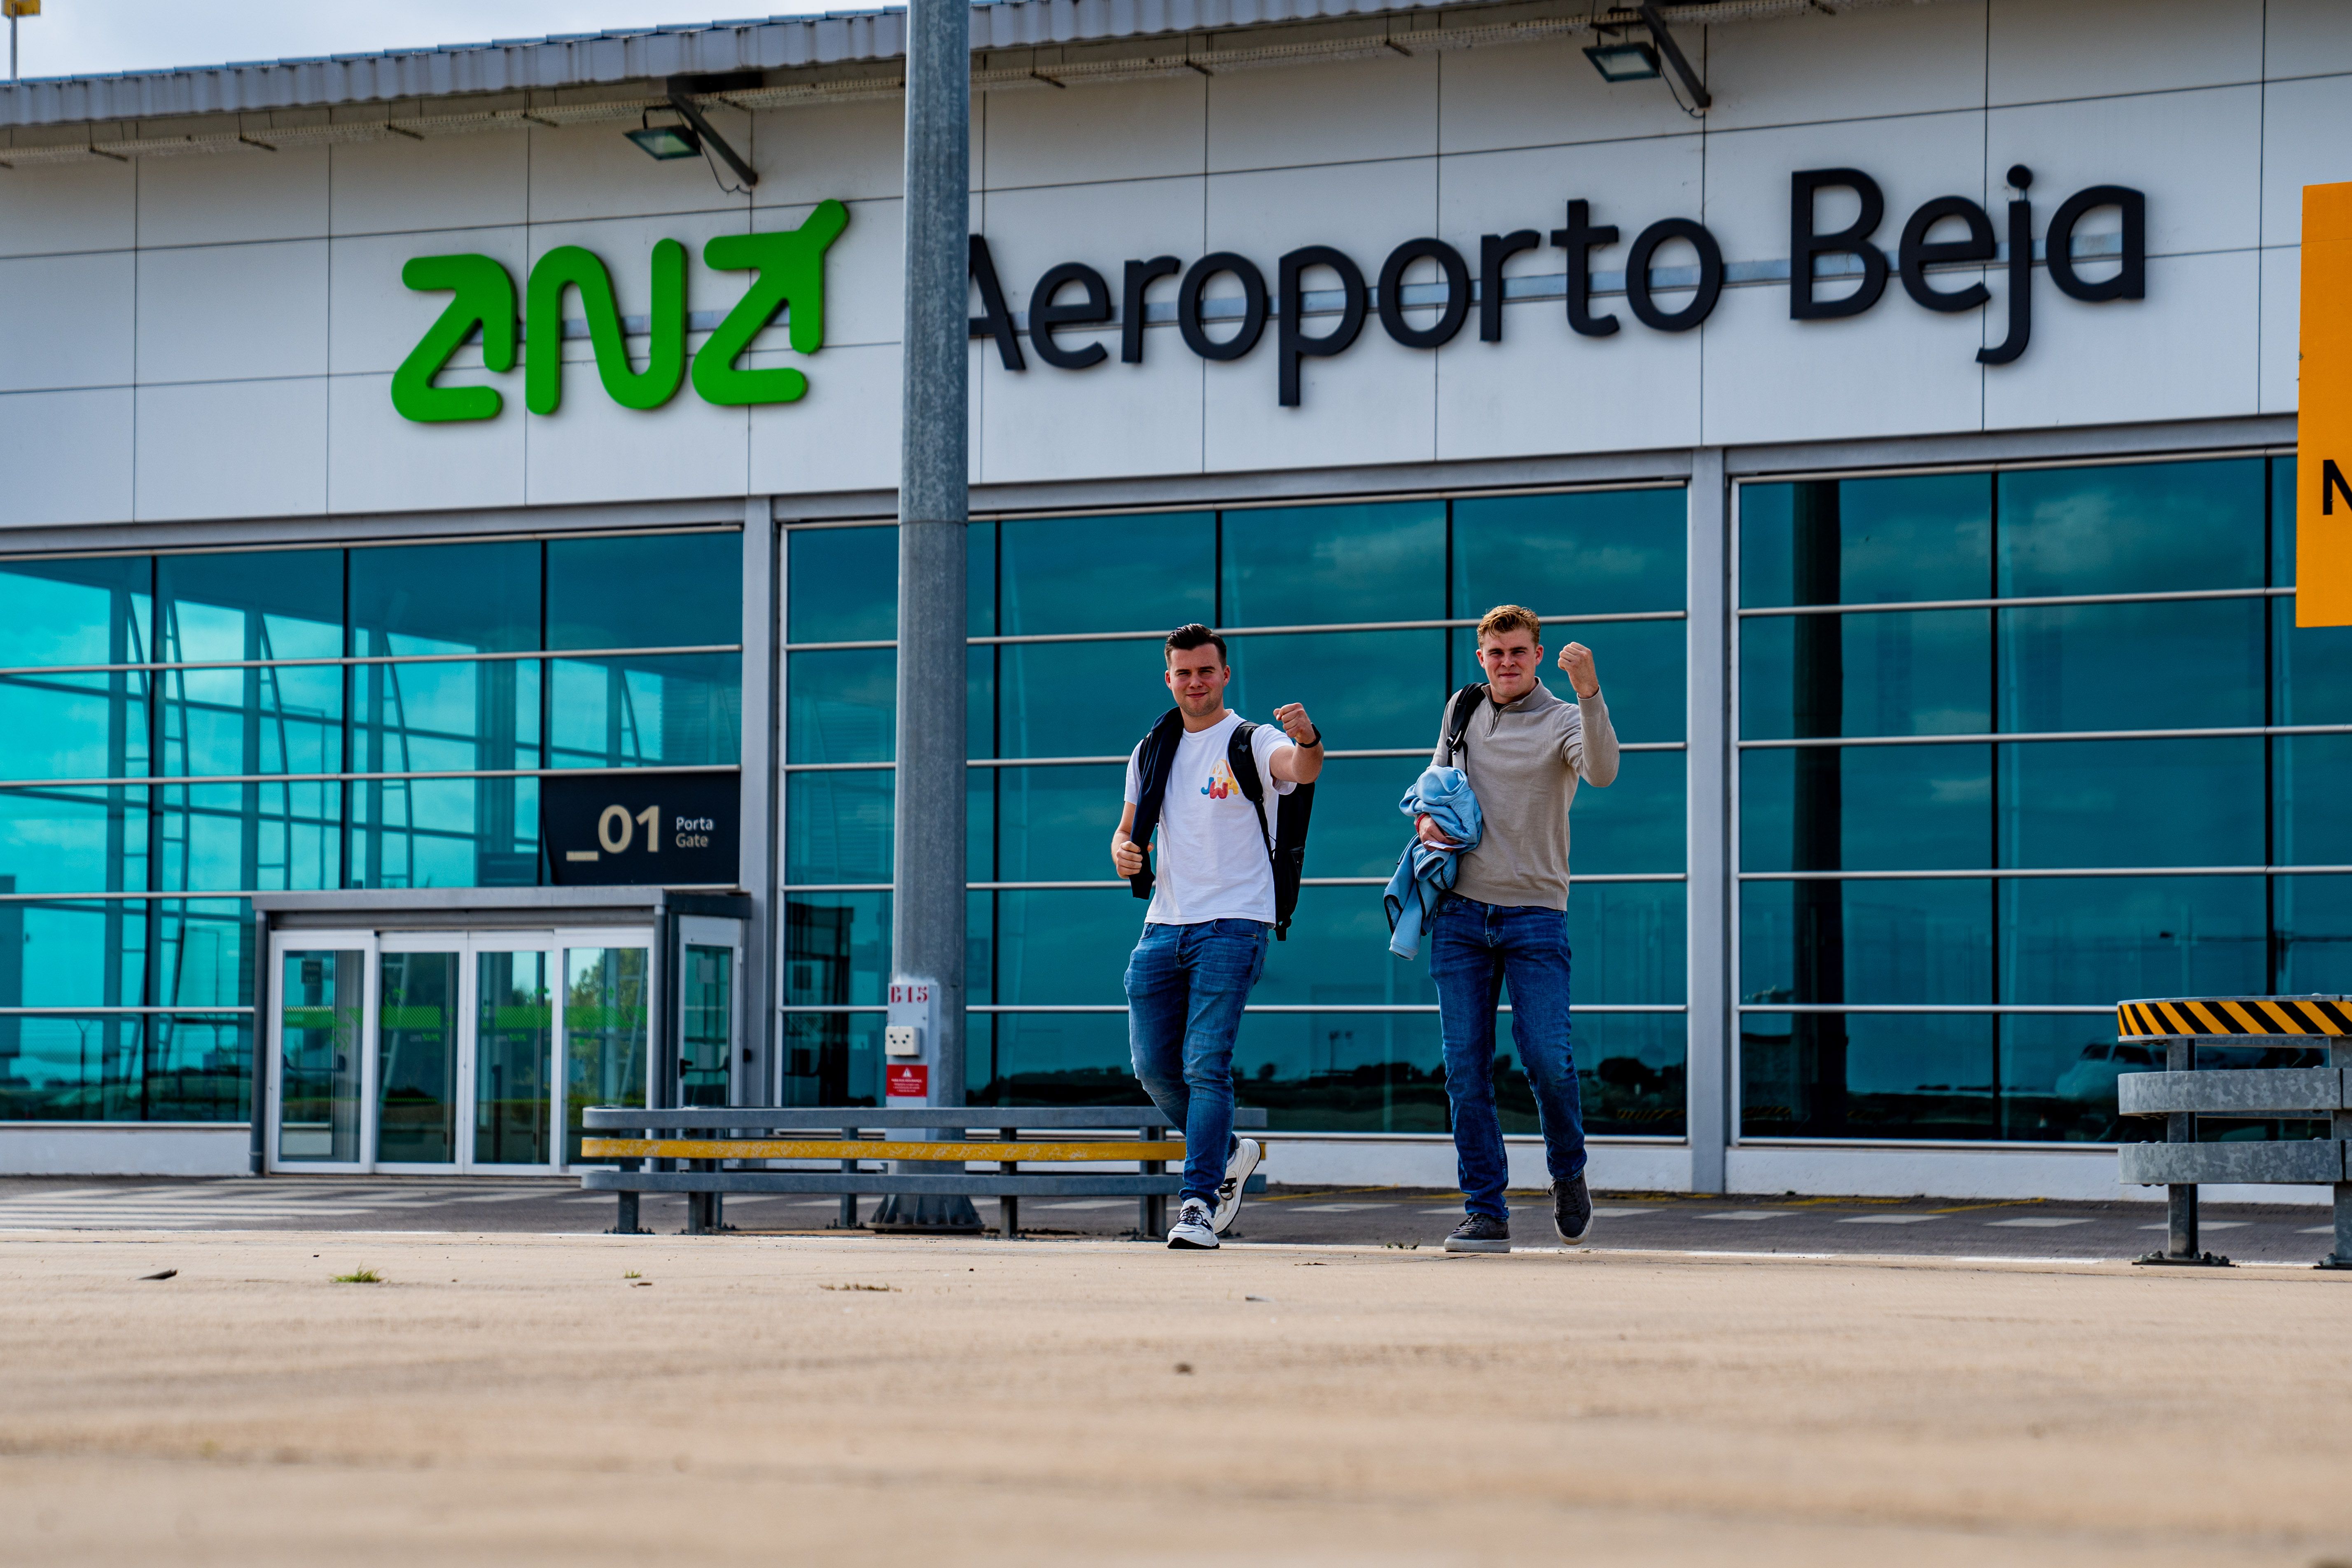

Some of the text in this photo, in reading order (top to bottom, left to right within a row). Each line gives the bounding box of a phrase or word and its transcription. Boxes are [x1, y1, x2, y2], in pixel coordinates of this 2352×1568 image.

[1790, 164, 2145, 365] Beja
[676, 816, 714, 831] Porta
[676, 833, 708, 848] Gate
